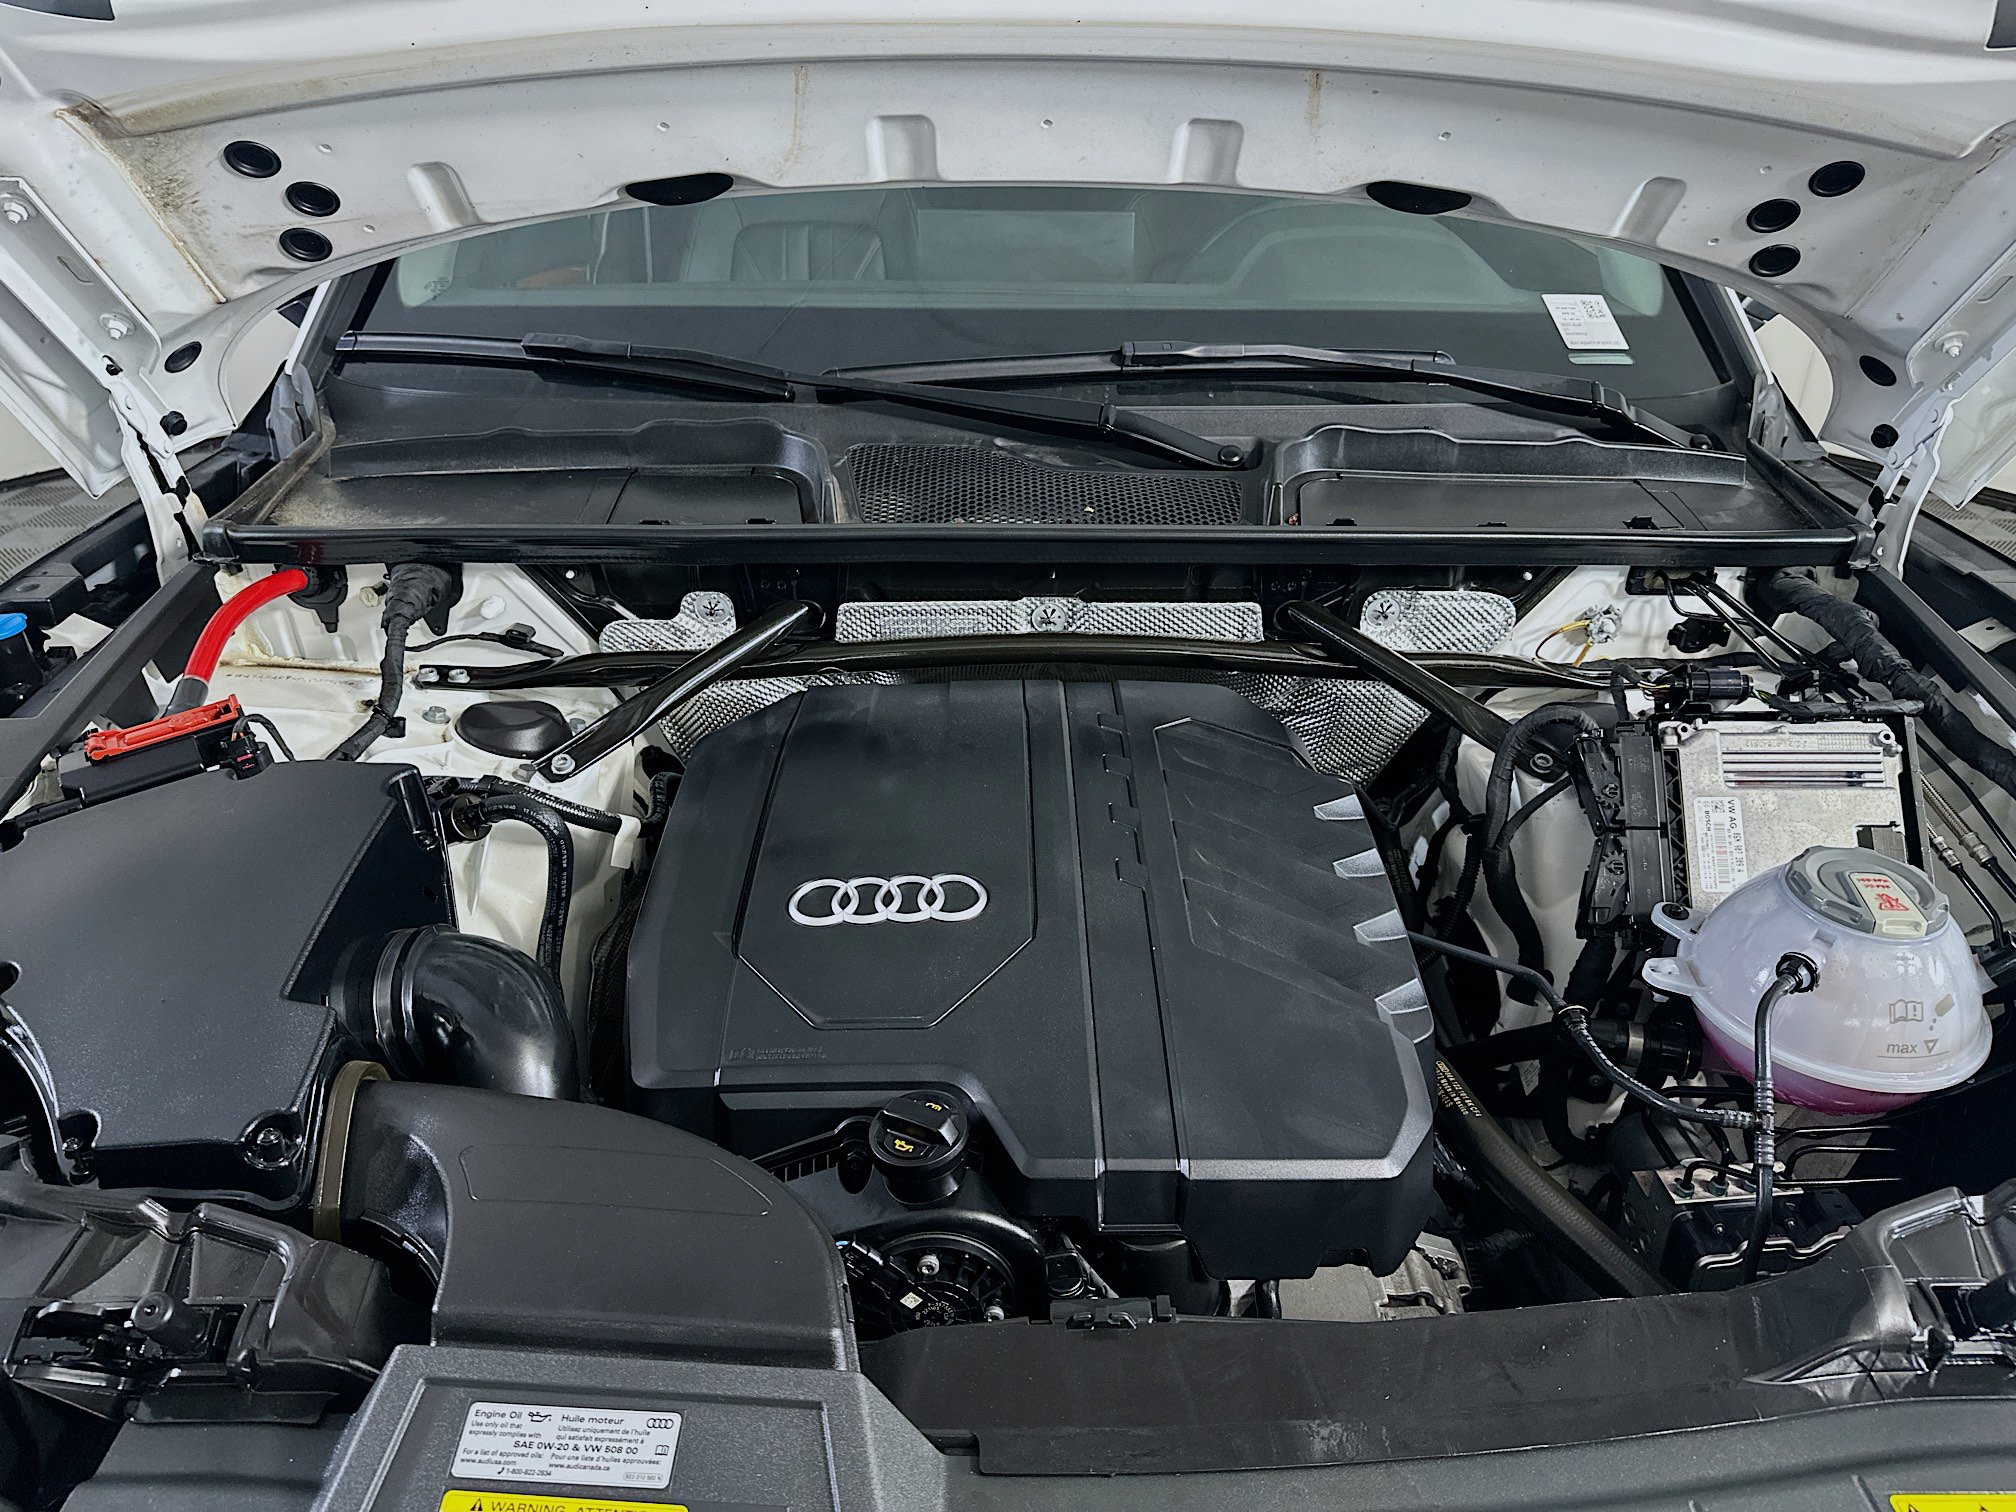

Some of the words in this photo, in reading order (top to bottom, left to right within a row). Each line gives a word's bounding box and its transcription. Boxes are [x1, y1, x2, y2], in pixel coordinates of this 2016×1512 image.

[1728, 800, 1736, 814] VW
[1729, 816, 1738, 829] AG
[1886, 1043, 1918, 1054] max
[474, 1409, 507, 1419] Engine
[509, 1411, 523, 1419] Oil
[561, 1414, 586, 1423] Huile
[587, 1417, 625, 1425] moteur
[484, 1421, 499, 1429] only
[558, 1425, 582, 1433] Utilisez
[582, 1427, 620, 1435] uniquement
[498, 1431, 527, 1439] complies
[567, 1434, 593, 1442] satisfait
[513, 1440, 535, 1449] SAE
[536, 1442, 569, 1451] 0W-20
[571, 1443, 580, 1452] &
[584, 1444, 602, 1453] VW
[604, 1445, 623, 1454] 508
[625, 1446, 639, 1455] 00
[499, 1450, 530, 1459] approved
[460, 1458, 517, 1466] www.audiusa.com
[548, 1462, 610, 1471] www.audicanada.ca
[491, 1501, 566, 1512] WARNING
